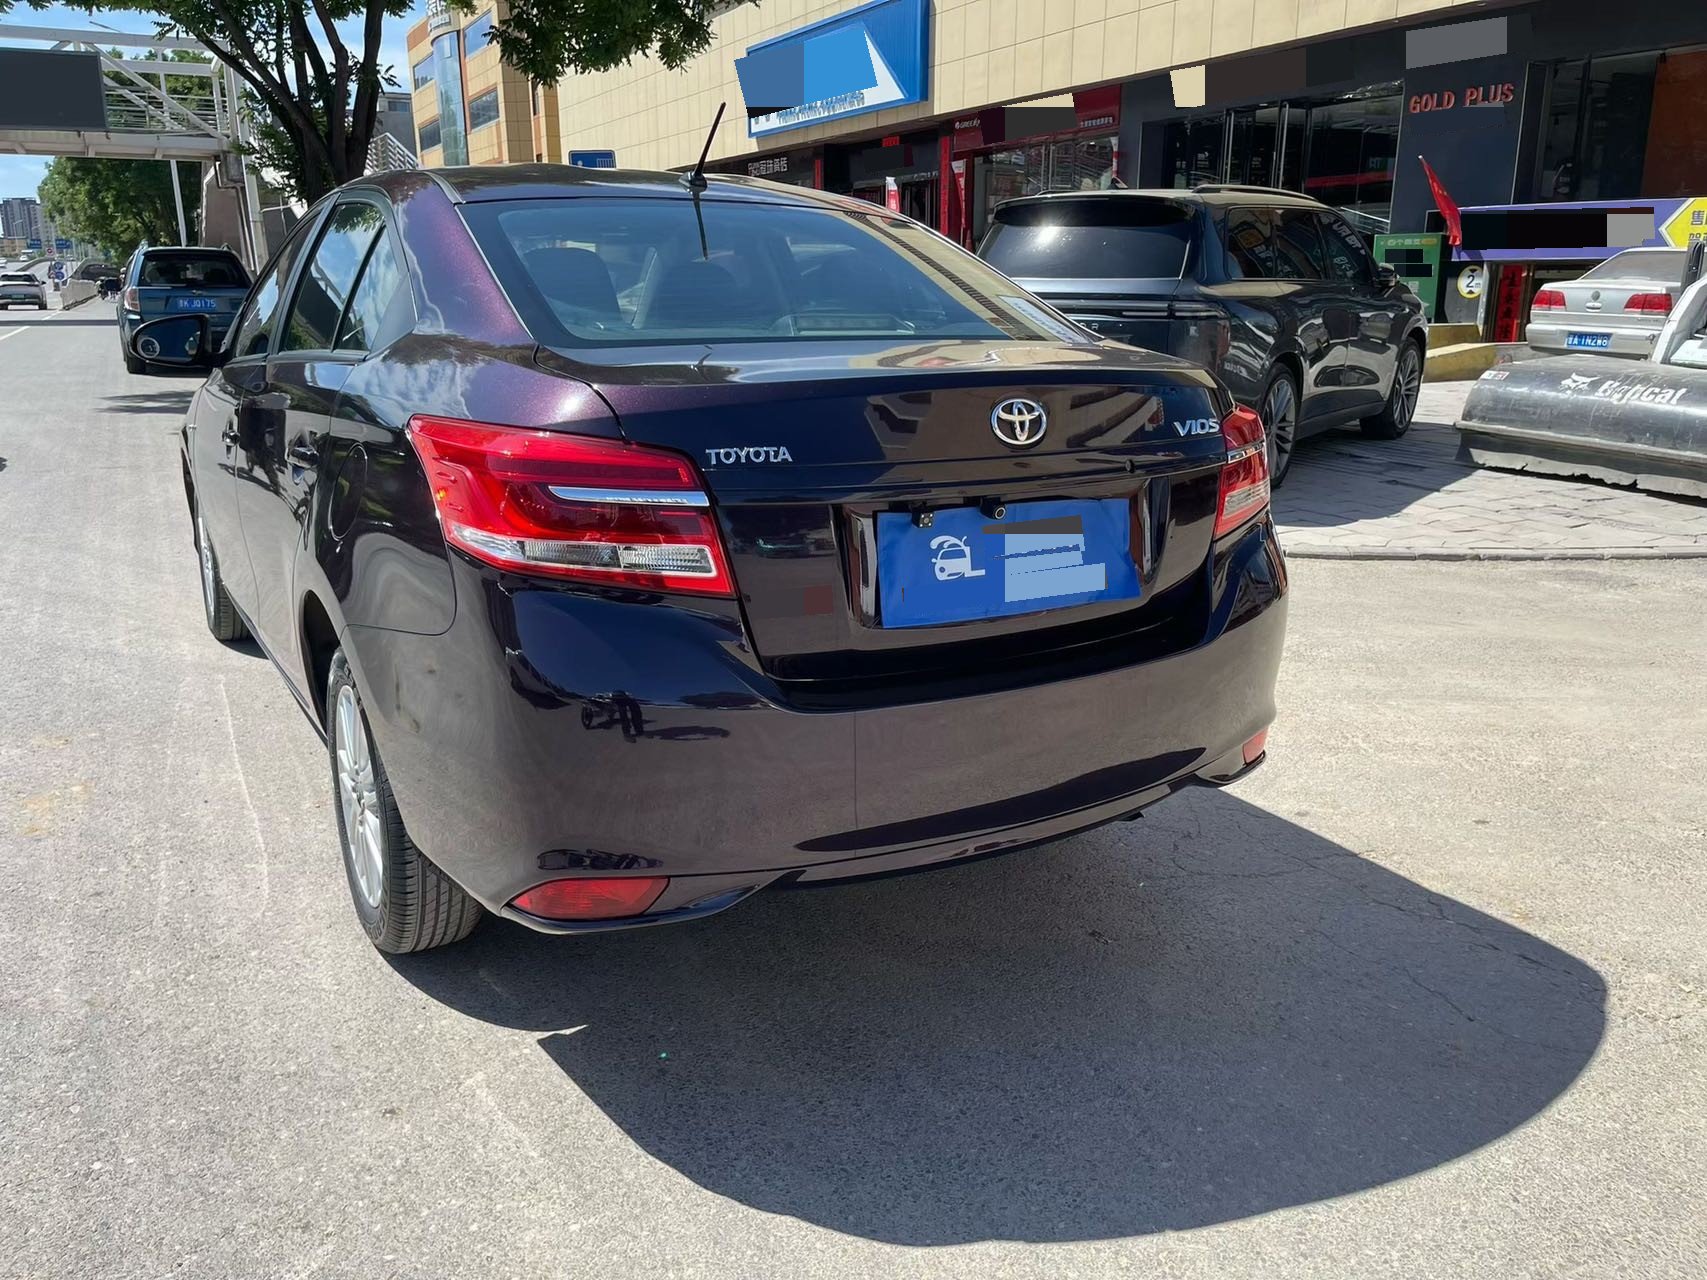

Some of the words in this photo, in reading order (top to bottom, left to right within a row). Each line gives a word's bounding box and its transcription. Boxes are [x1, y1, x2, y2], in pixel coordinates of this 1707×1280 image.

[1409, 91, 1455, 113] GOLD
[1464, 83, 1515, 106] PLUS
[1173, 418, 1220, 437] VIOS
[705, 446, 793, 465] TOYOTA
